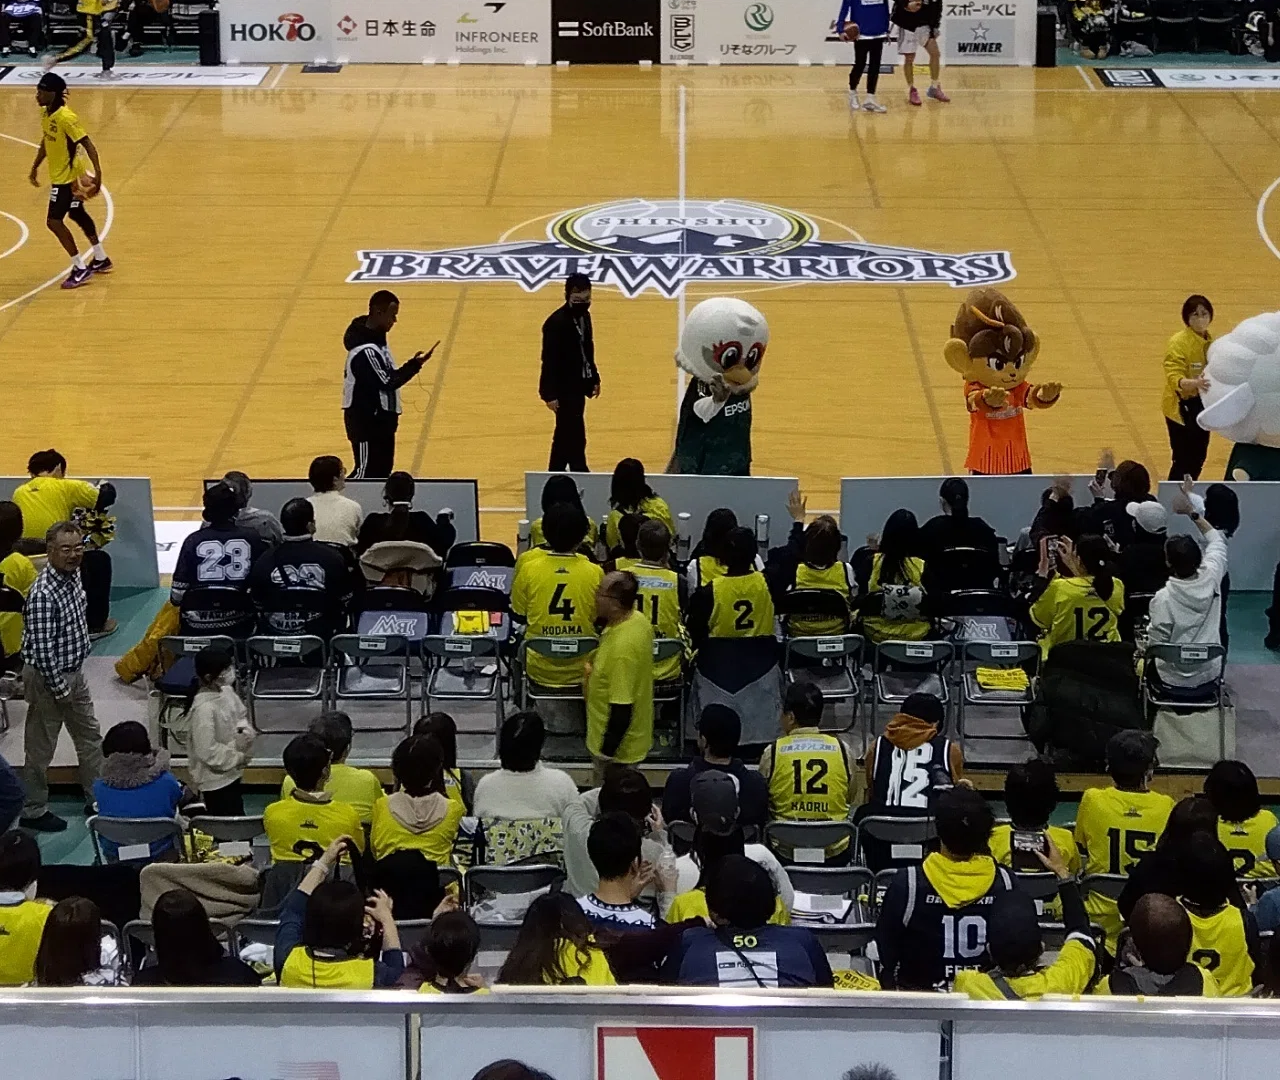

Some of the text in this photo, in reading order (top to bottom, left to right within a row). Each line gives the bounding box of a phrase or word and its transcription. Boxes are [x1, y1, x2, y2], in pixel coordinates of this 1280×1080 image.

[946, 3, 1016, 17] スポーツくじ
[230, 13, 316, 41] HOKTO
[365, 19, 436, 38] 日本生命
[582, 21, 654, 37] SoftBank
[455, 30, 539, 43] INFRONEER
[455, 45, 494, 55] Holdings
[720, 42, 797, 56] りそなグループ
[957, 42, 1002, 54] WINNER
[592, 216, 771, 226] SHINSHU
[196, 539, 251, 581] 23
[548, 583, 575, 622] 4
[733, 599, 754, 631] 2
[542, 625, 583, 636] KODAMA
[1073, 607, 1109, 642] 12
[792, 758, 829, 795] 12
[791, 801, 829, 813] KAORU
[732, 935, 758, 948] 50
[941, 914, 987, 959] 10
